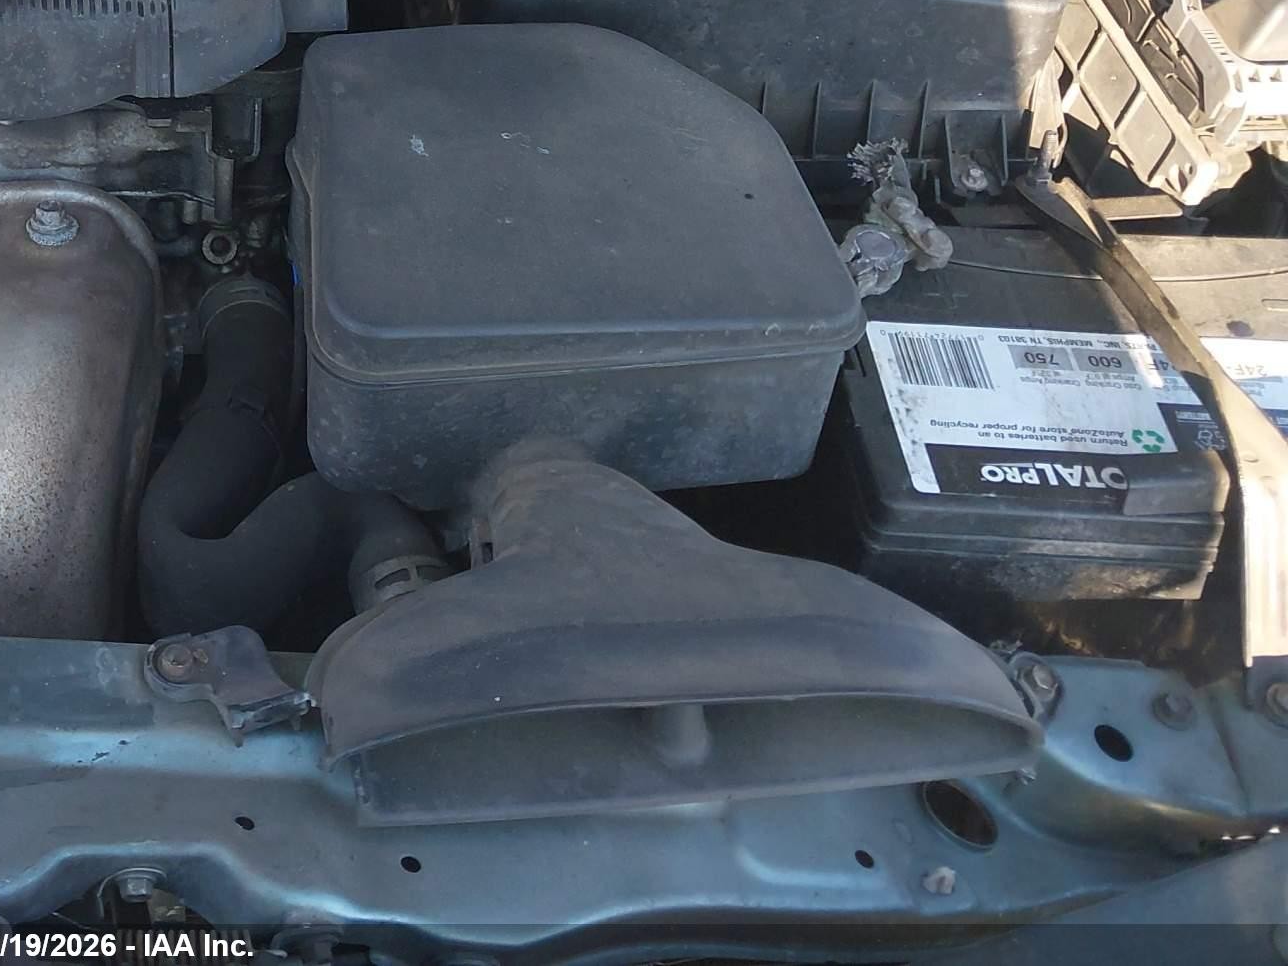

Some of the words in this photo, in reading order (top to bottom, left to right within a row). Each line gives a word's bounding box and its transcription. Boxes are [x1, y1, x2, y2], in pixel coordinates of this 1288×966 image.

[1023, 351, 1060, 366] 750
[1087, 355, 1122, 369] 600
[929, 418, 980, 430] recycling
[982, 422, 1018, 432] proper
[1021, 424, 1037, 433] for
[1039, 425, 1068, 434] store
[994, 431, 1005, 440] to
[1007, 432, 1057, 442] batteries
[1059, 434, 1088, 443] used
[1090, 435, 1128, 447] Return
